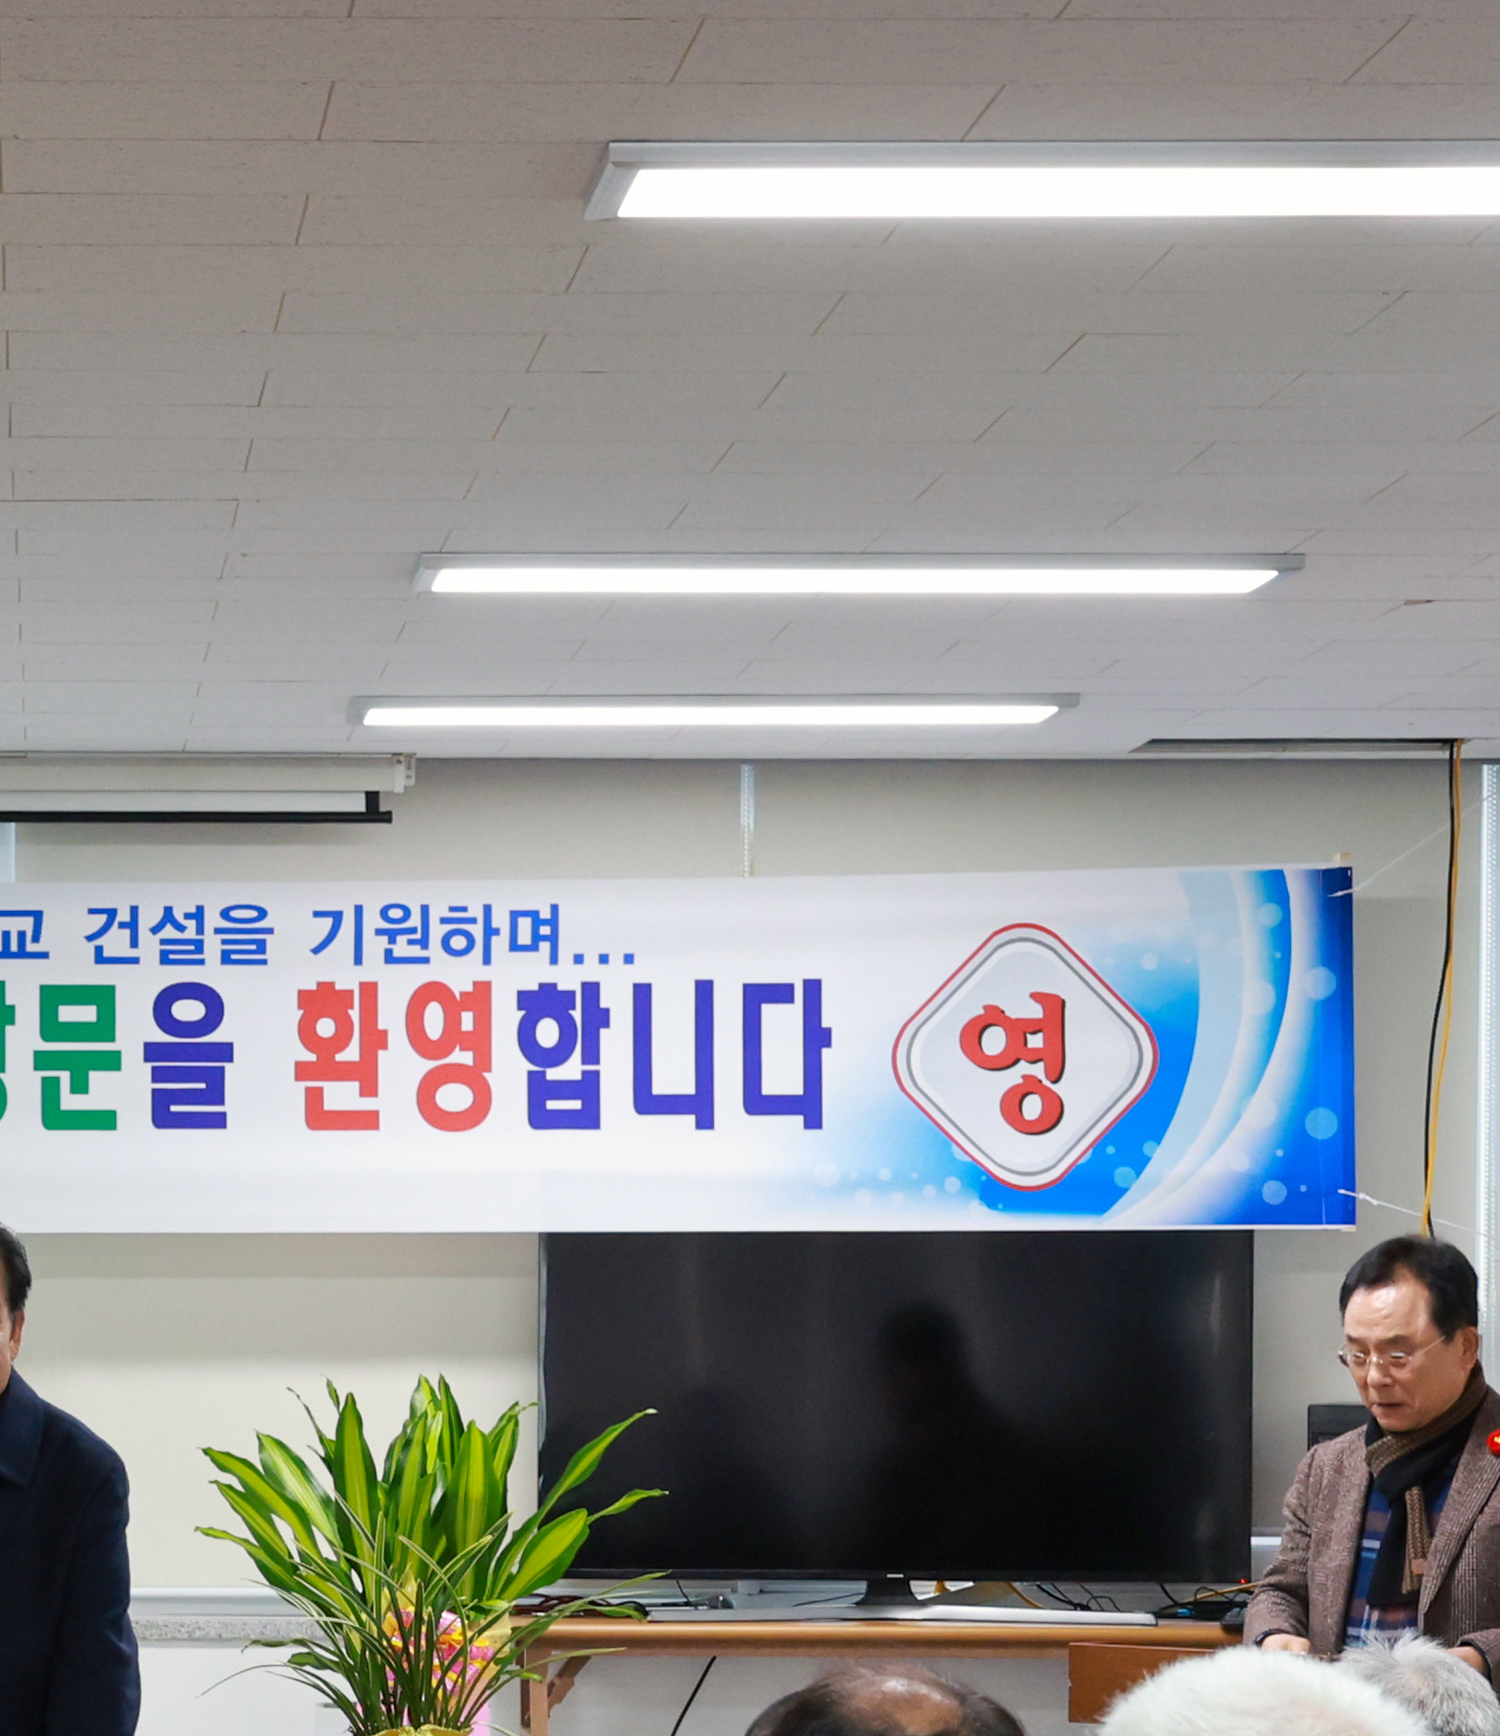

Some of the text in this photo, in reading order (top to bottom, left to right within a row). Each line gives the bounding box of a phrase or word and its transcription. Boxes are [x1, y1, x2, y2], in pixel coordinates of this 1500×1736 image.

[83, 904, 275, 966] 건설을
[310, 903, 635, 966] 기원하며...
[294, 978, 832, 1132] 환영합니다
[958, 990, 1068, 1137] 영
